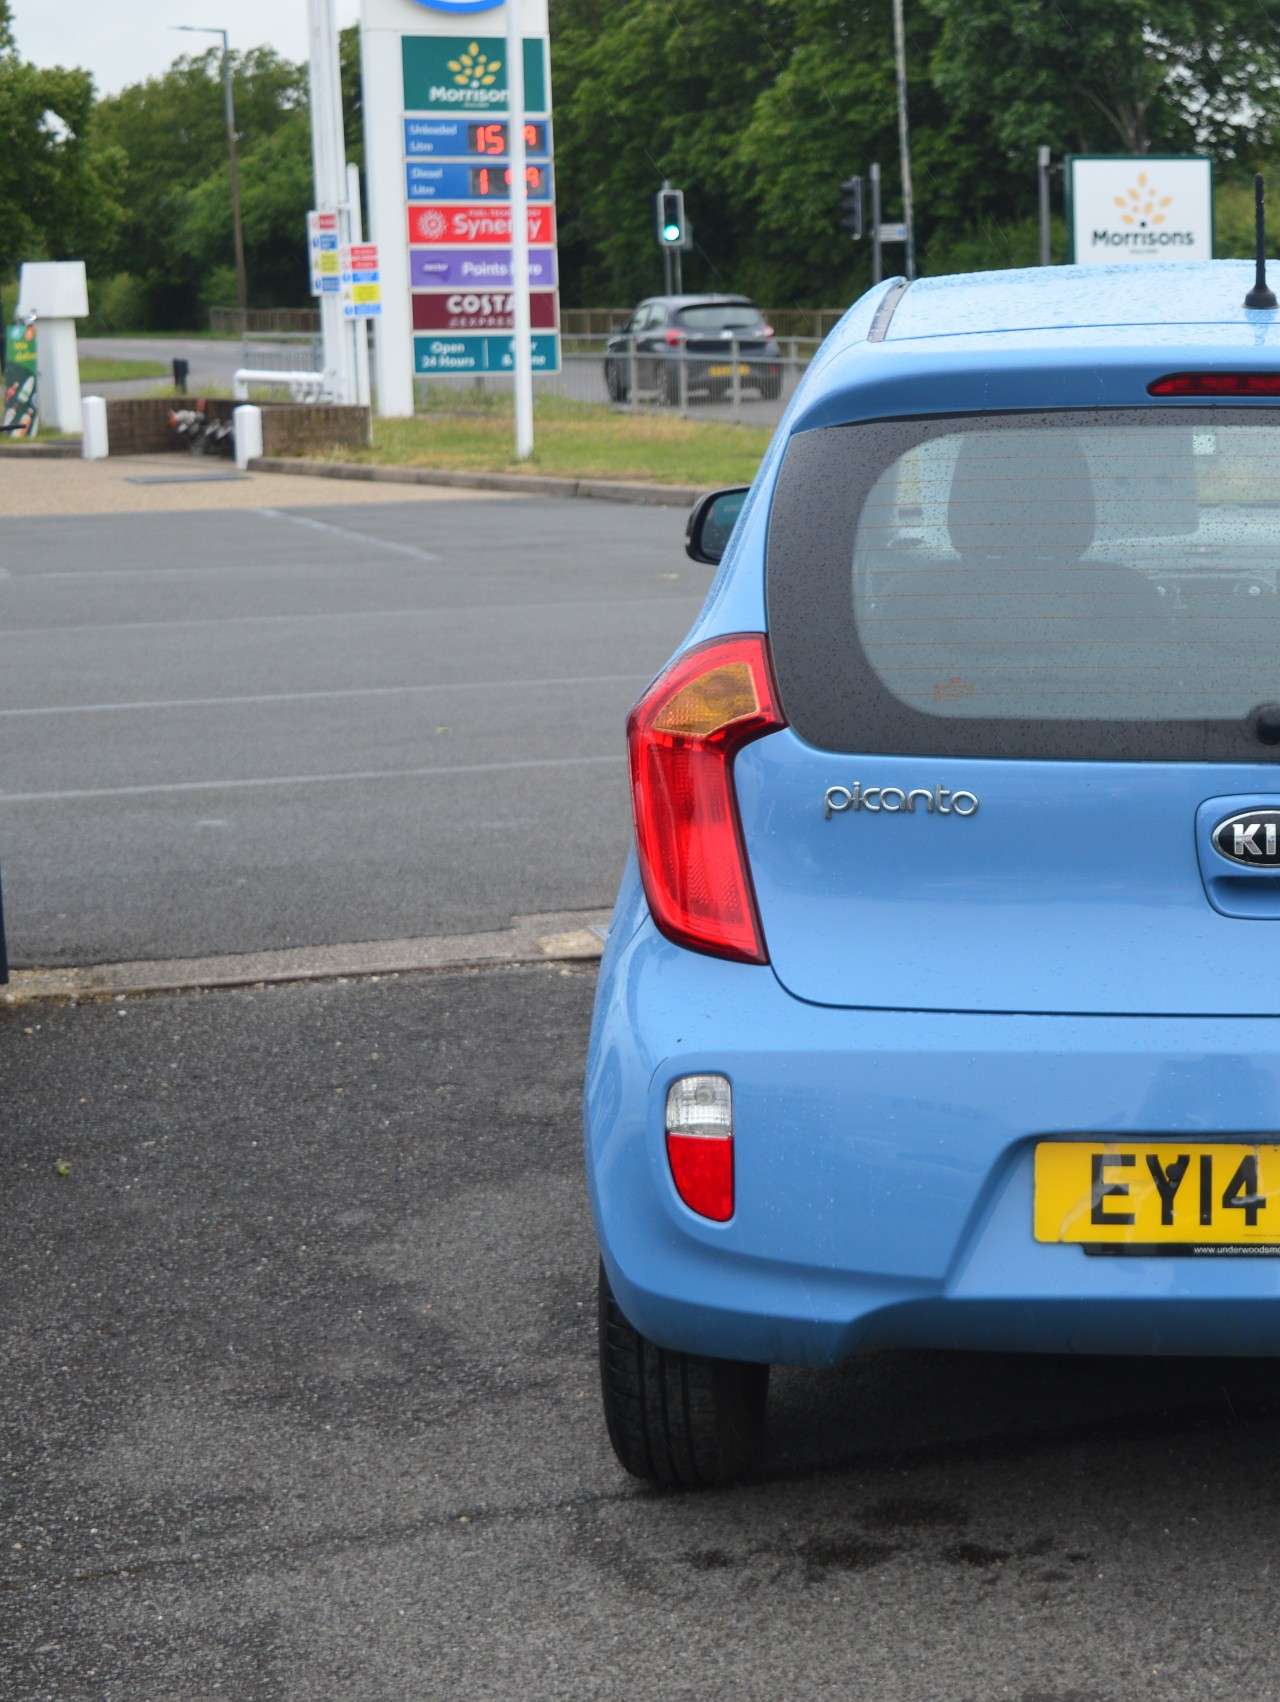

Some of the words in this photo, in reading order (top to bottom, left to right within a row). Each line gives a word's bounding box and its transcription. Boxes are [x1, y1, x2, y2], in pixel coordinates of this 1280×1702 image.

[429, 86, 511, 102] Morrison
[411, 167, 443, 179] Diesel
[1092, 230, 1194, 246] Morrisons
[461, 262, 508, 276] Points
[430, 342, 465, 354] Open
[422, 356, 437, 368] 24
[441, 355, 476, 368] Hours
[824, 781, 980, 818] picanto
[1090, 1153, 1267, 1227] EY14
